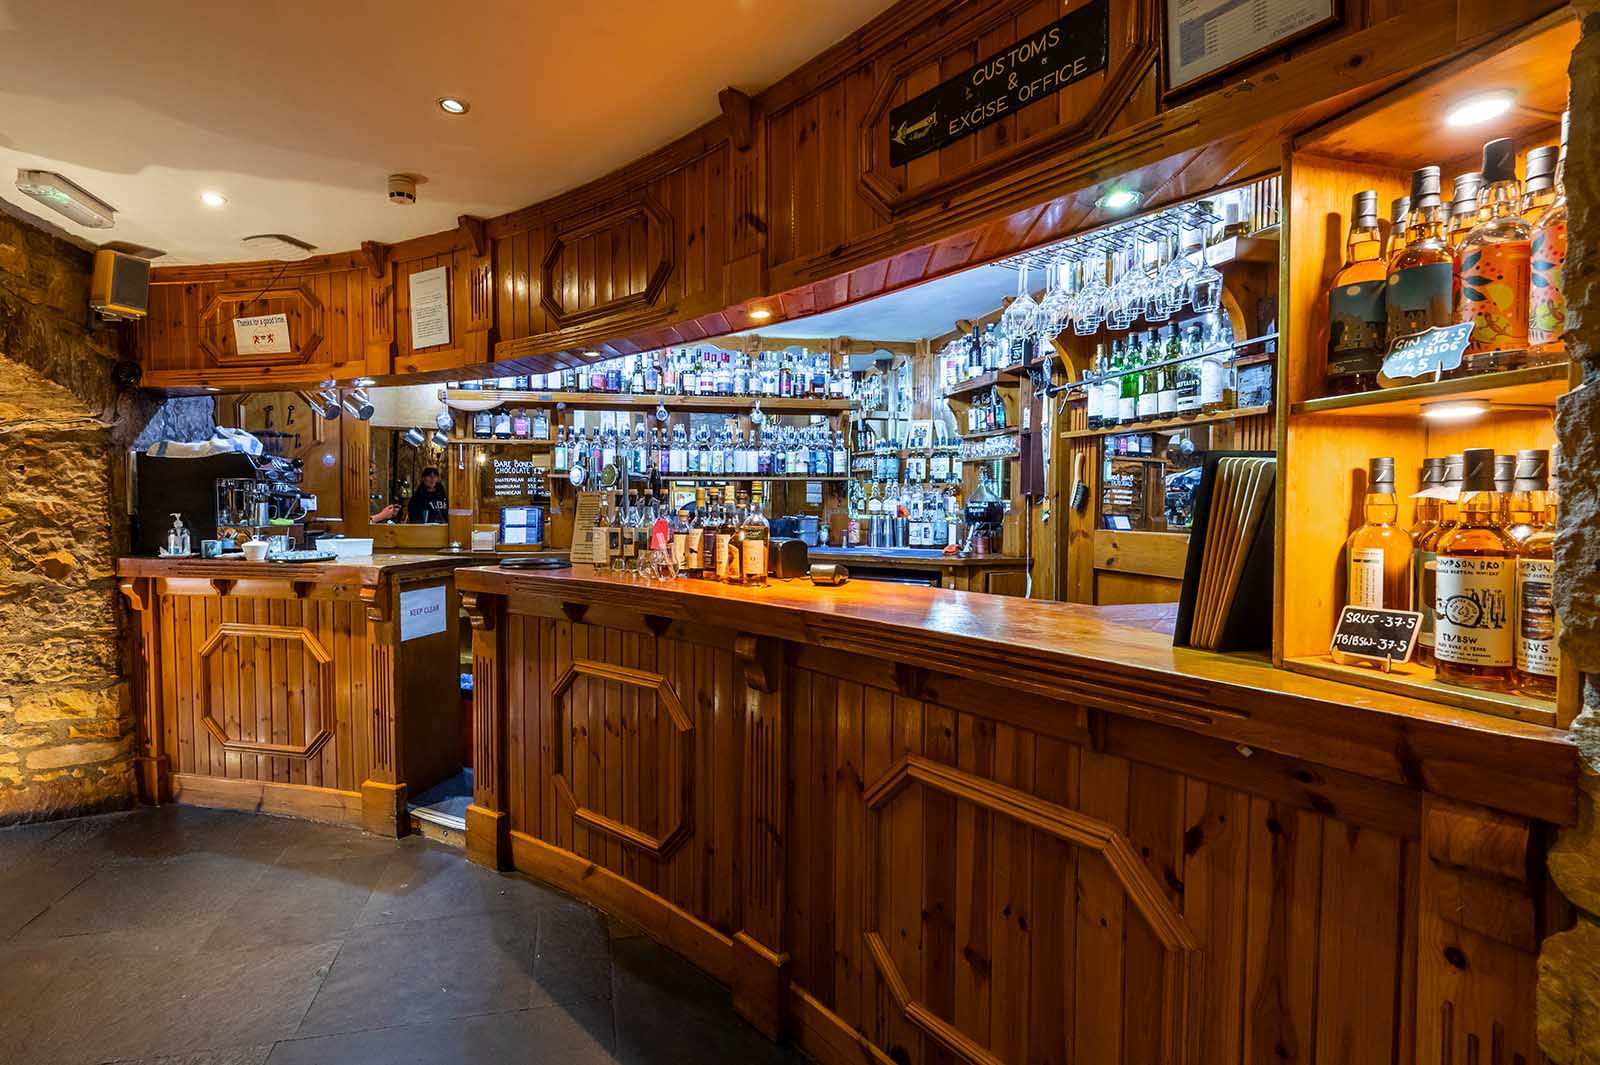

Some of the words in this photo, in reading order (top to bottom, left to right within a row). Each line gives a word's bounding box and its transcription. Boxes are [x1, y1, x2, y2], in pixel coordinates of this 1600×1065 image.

[972, 27, 1060, 86] CUSTOMS
[1007, 72, 1019, 90] &
[949, 95, 1009, 135] EXCISE
[1018, 56, 1088, 102] OFFICE
[1395, 336, 1420, 349] GIN
[1443, 633, 1477, 644] TB/BSW
